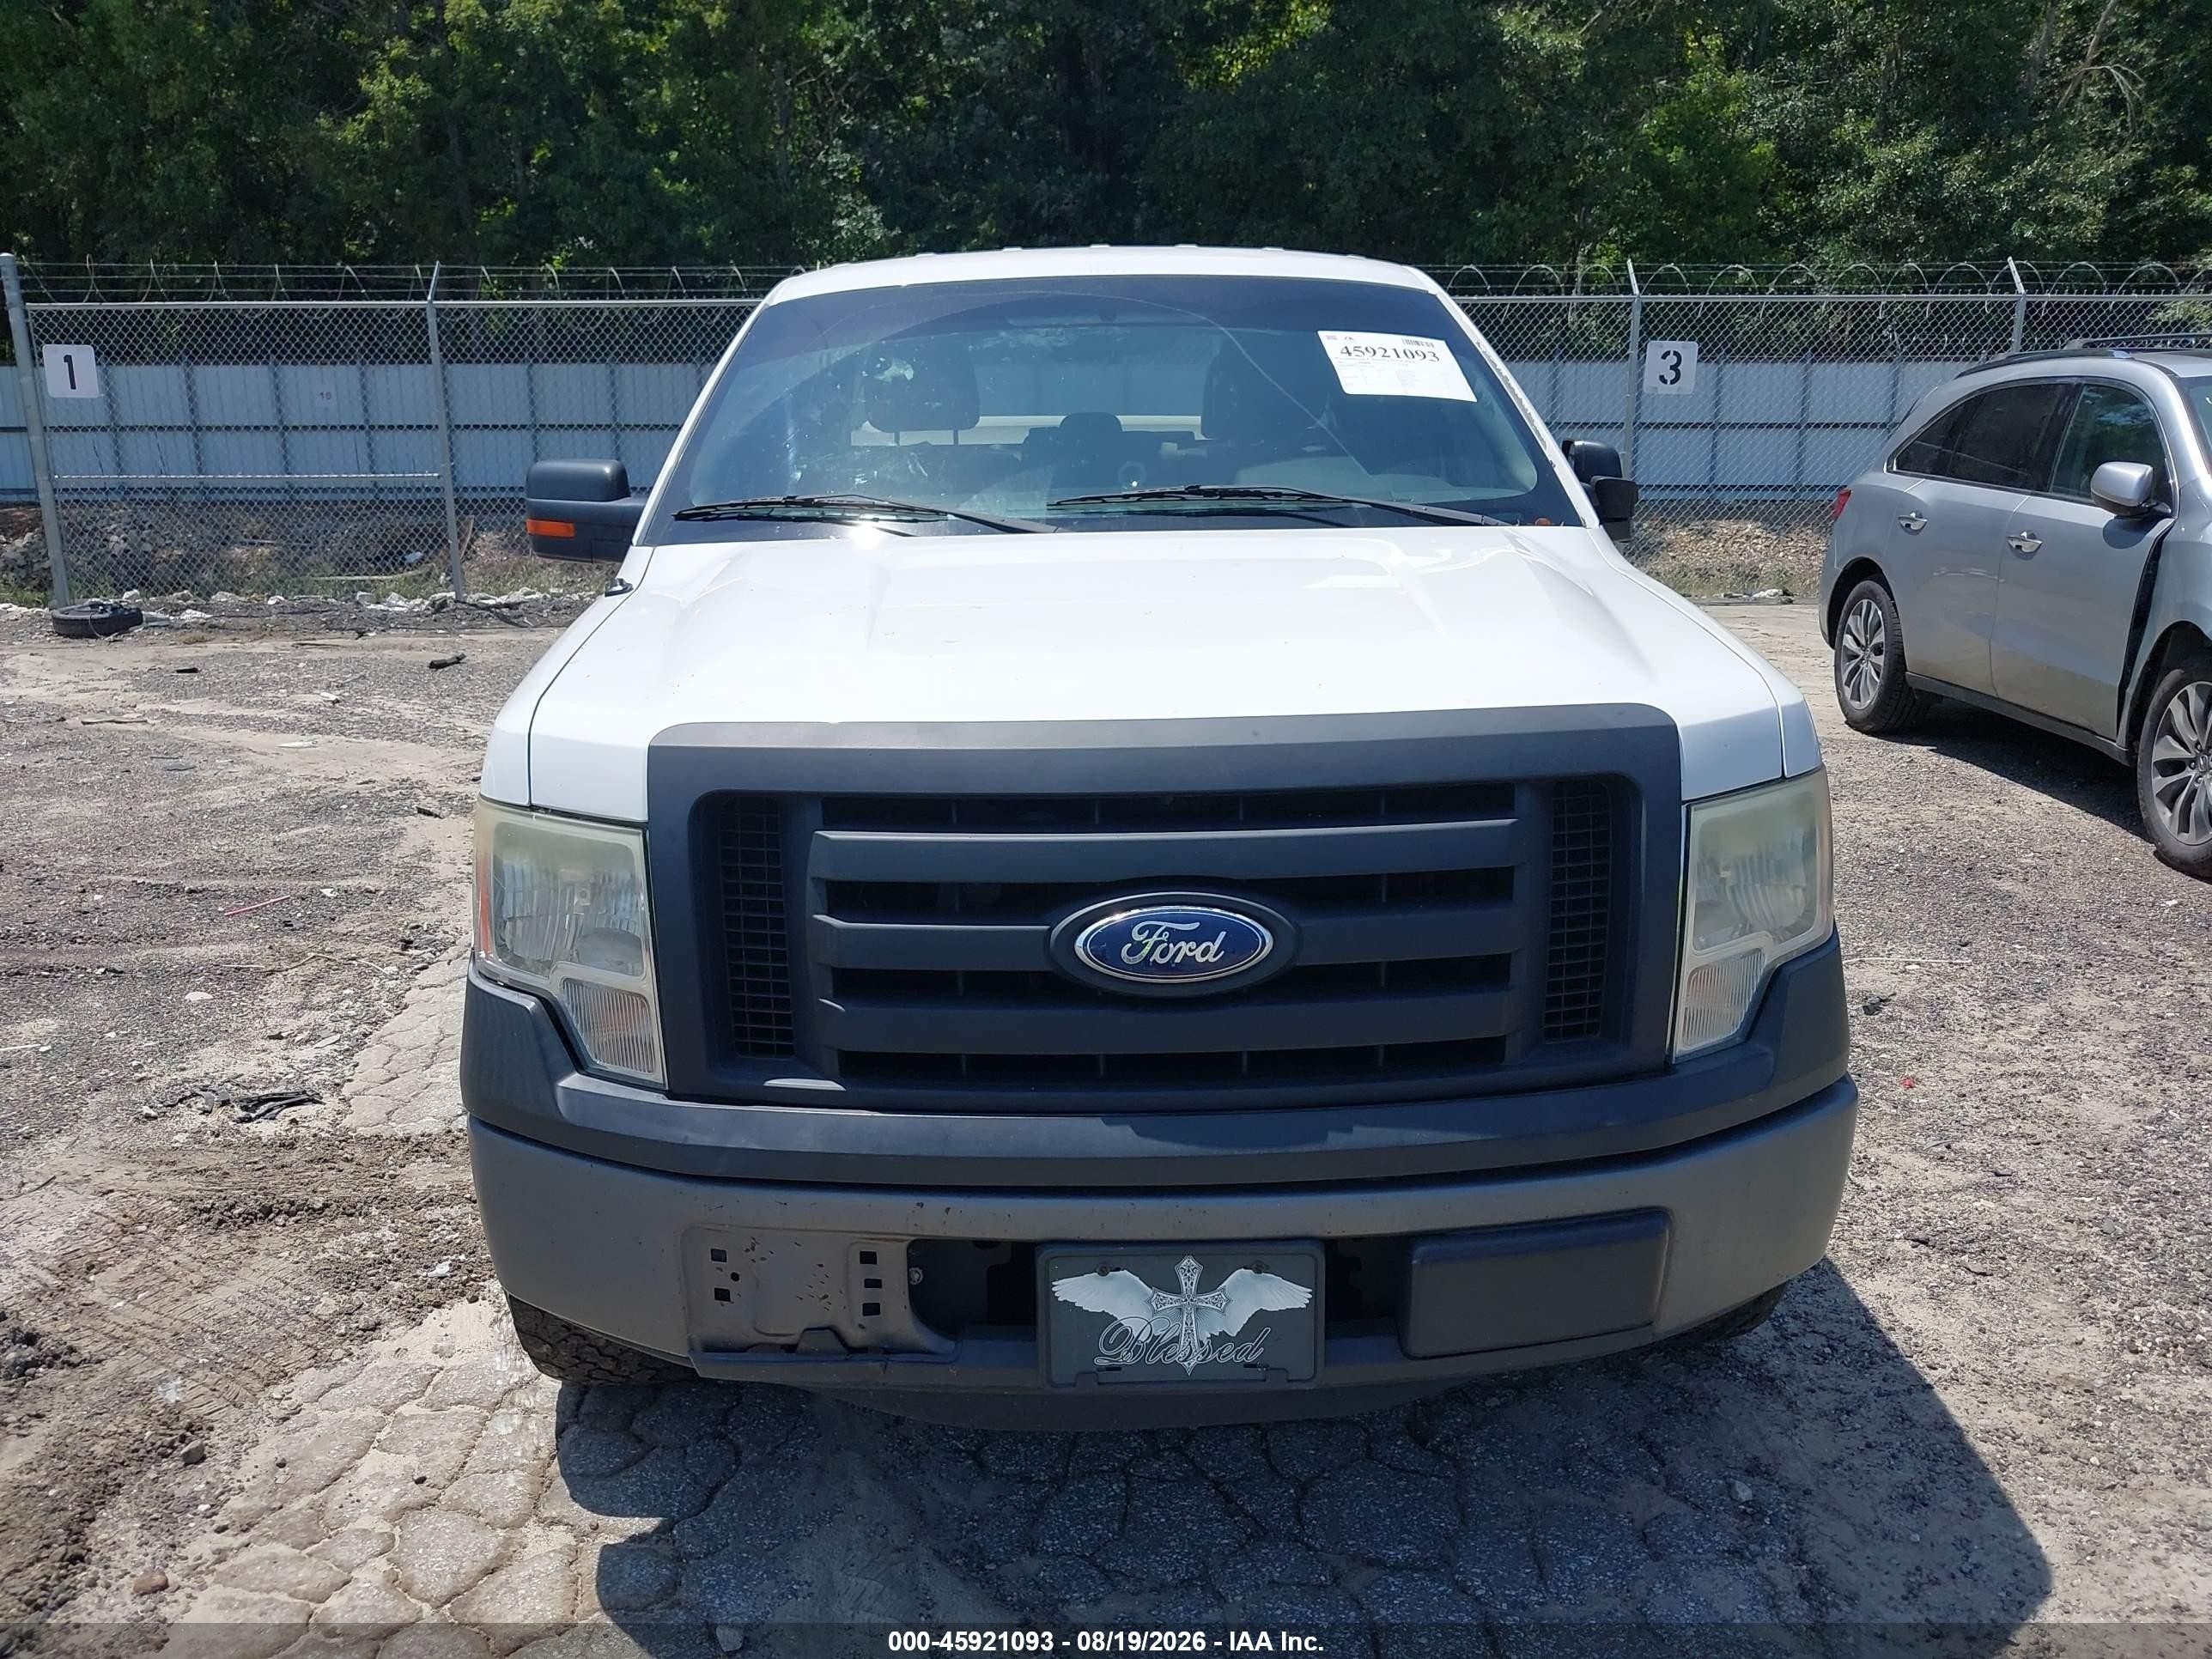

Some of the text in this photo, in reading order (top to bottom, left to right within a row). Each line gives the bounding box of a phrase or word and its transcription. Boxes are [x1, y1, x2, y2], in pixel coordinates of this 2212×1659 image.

[63, 354, 76, 390] 1
[1340, 345, 1440, 362] 45921093
[1658, 349, 1682, 386] 3
[1121, 921, 1227, 964] Ford
[1094, 1316, 1272, 1365] Blessed
